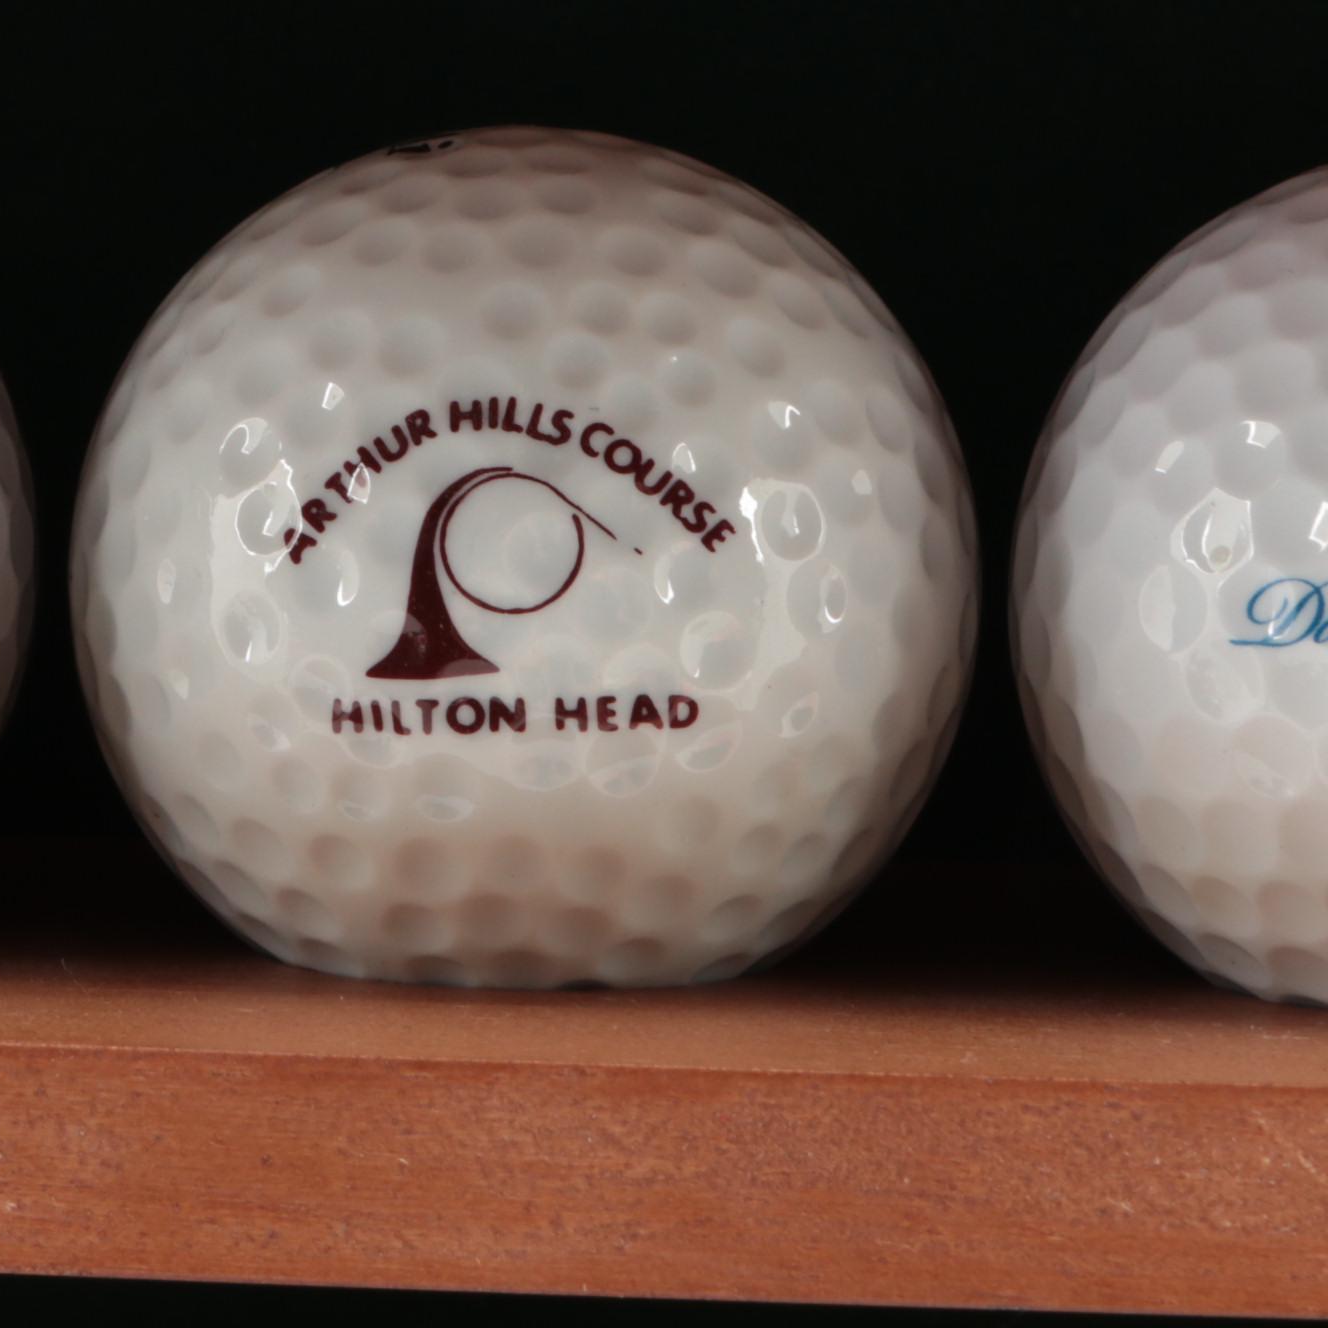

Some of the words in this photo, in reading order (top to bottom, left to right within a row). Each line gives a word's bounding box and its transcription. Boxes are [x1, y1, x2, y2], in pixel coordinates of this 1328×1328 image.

[283, 408, 438, 565] ARTHUR
[449, 396, 574, 446] HILLS
[579, 421, 736, 553] COURSE
[331, 696, 527, 735] HILTON
[554, 694, 700, 733] HEAD
